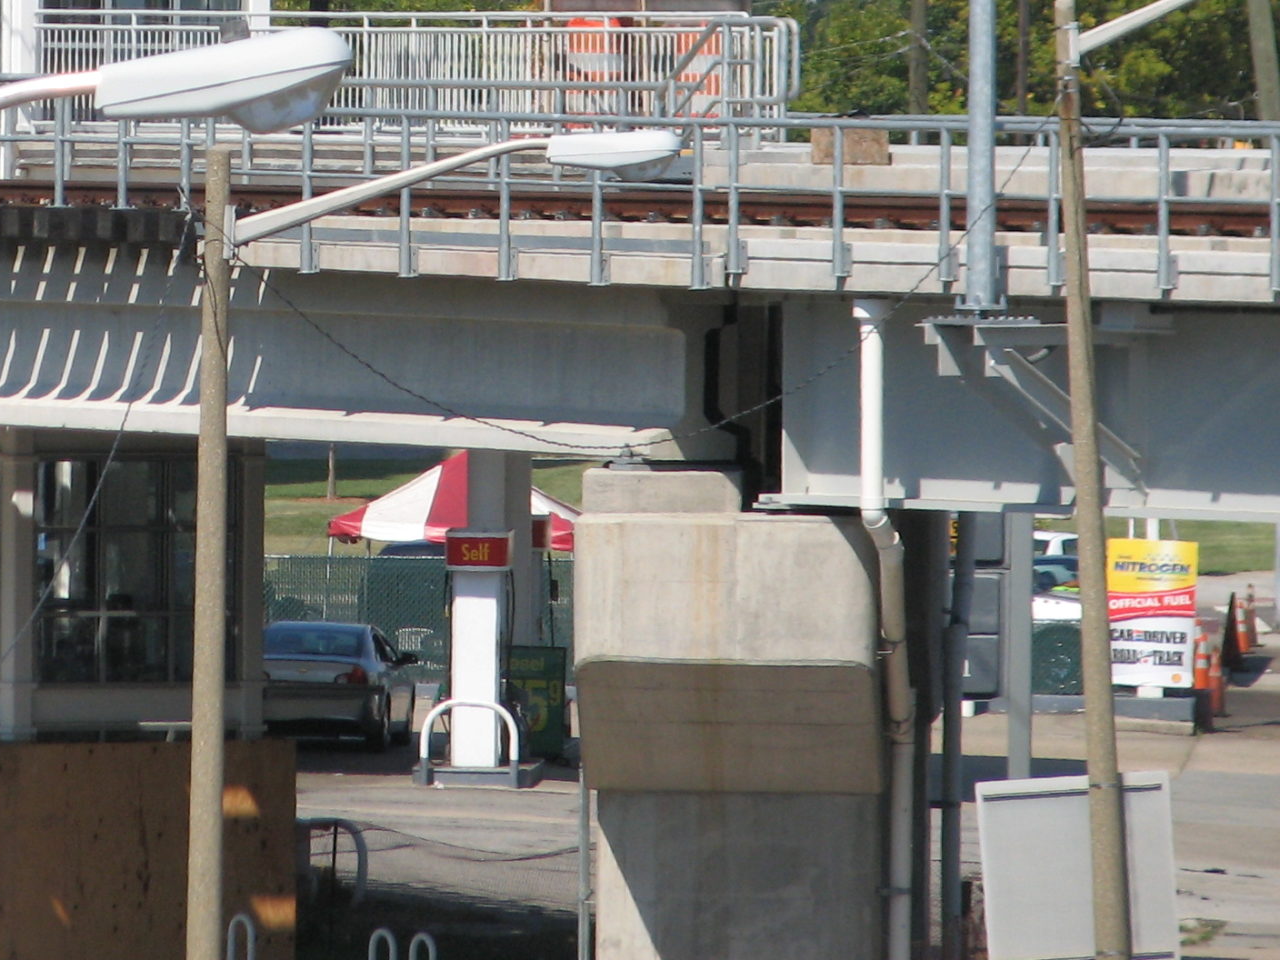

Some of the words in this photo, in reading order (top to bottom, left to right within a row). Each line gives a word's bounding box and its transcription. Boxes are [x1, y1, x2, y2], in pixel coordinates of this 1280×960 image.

[461, 543, 490, 561] Self
[1114, 561, 1191, 574] NITROGEN
[1108, 596, 1161, 610] OFFICIAL
[1163, 594, 1192, 606] FUEL
[1110, 628, 1133, 642] CAR
[1144, 630, 1187, 645] DRIVER
